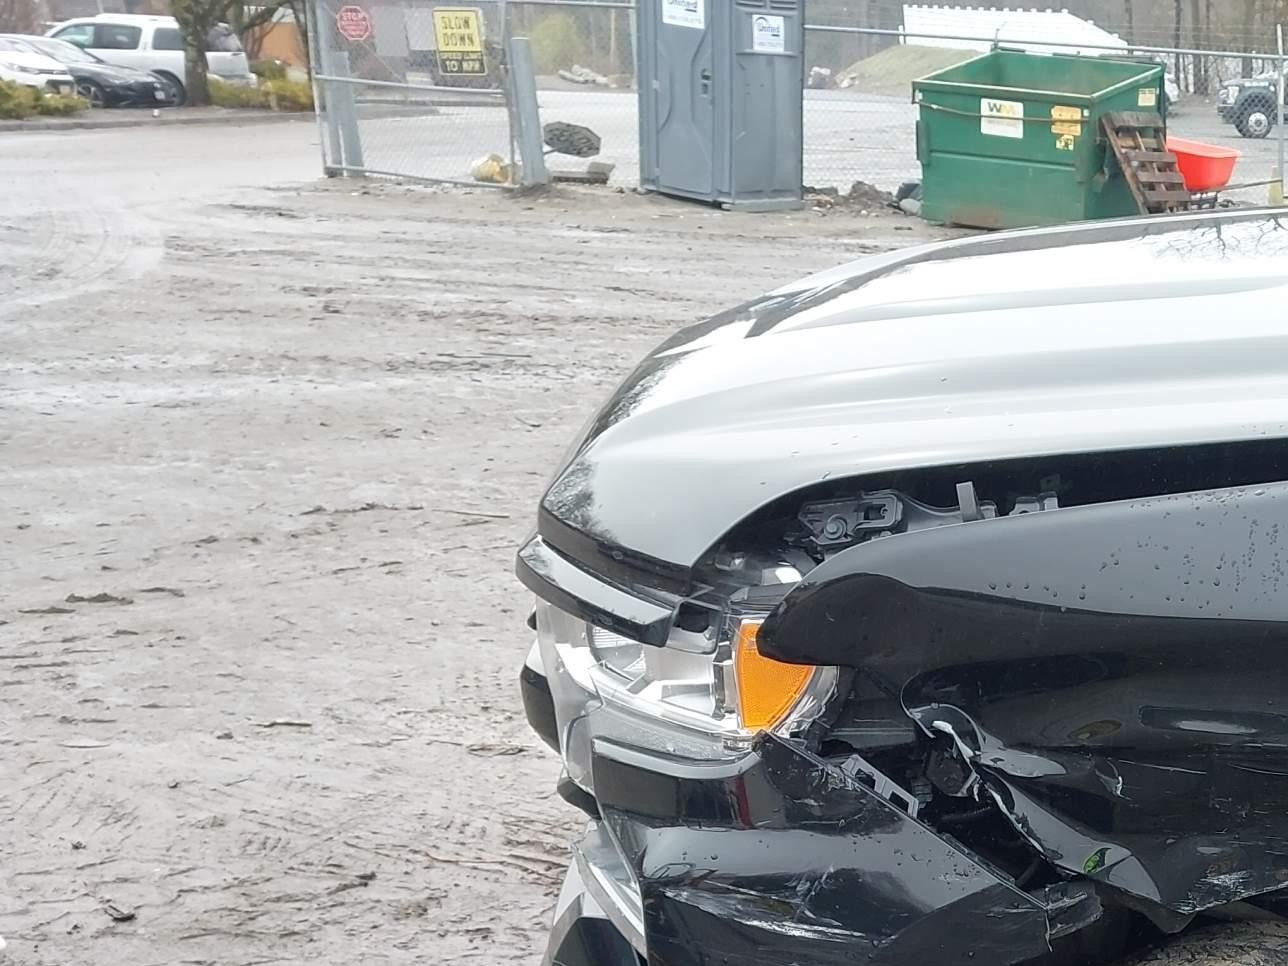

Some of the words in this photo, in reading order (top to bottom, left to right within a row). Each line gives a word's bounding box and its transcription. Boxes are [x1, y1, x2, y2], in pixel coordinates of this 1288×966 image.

[441, 16, 471, 29] SLOW
[442, 33, 475, 47] DOWN
[445, 60, 459, 71] 10
